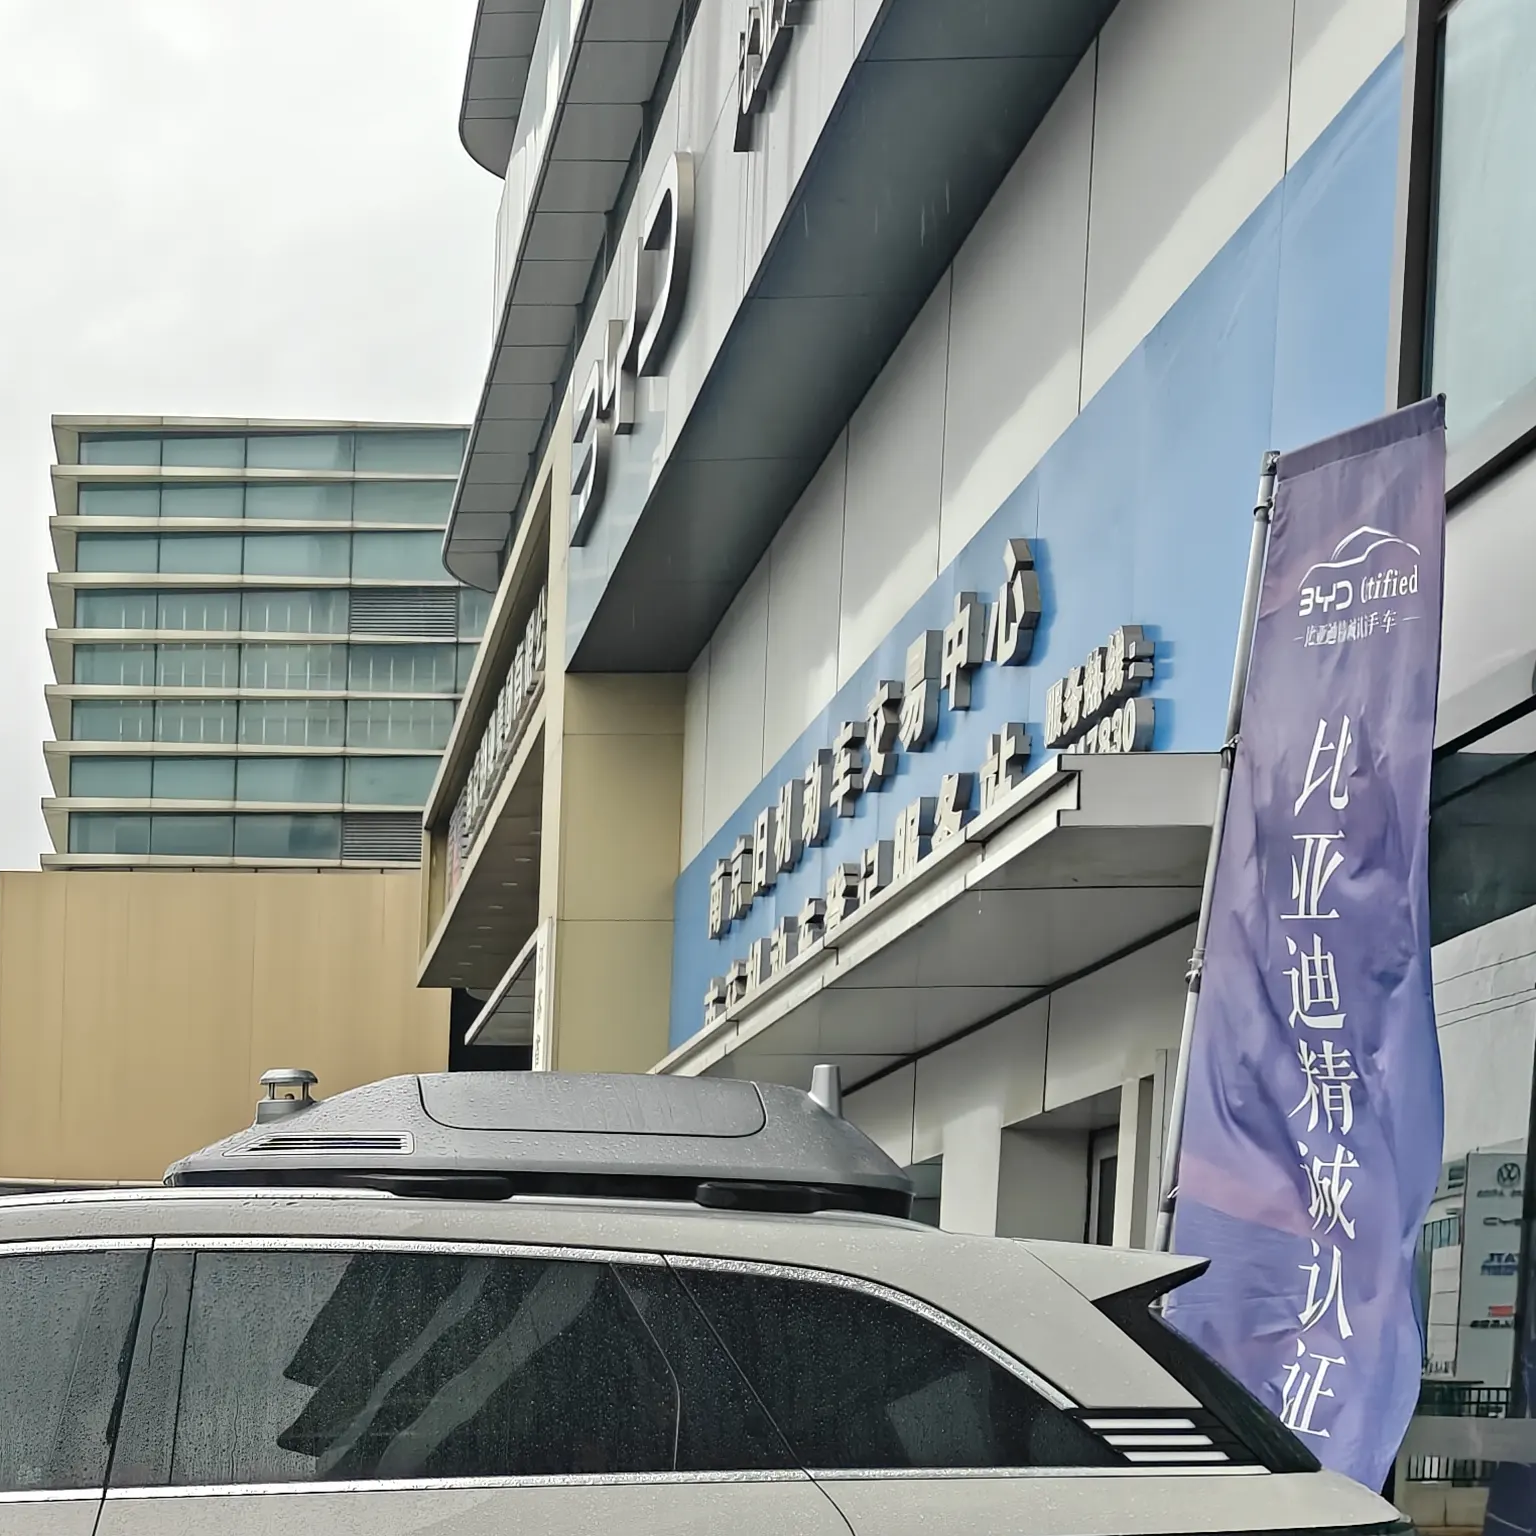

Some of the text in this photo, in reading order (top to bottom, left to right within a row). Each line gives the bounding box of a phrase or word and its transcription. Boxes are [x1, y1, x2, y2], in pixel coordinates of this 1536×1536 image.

[1299, 580, 1352, 616] BYD
[1279, 714, 1361, 1438] 比亚迪精诚认证
